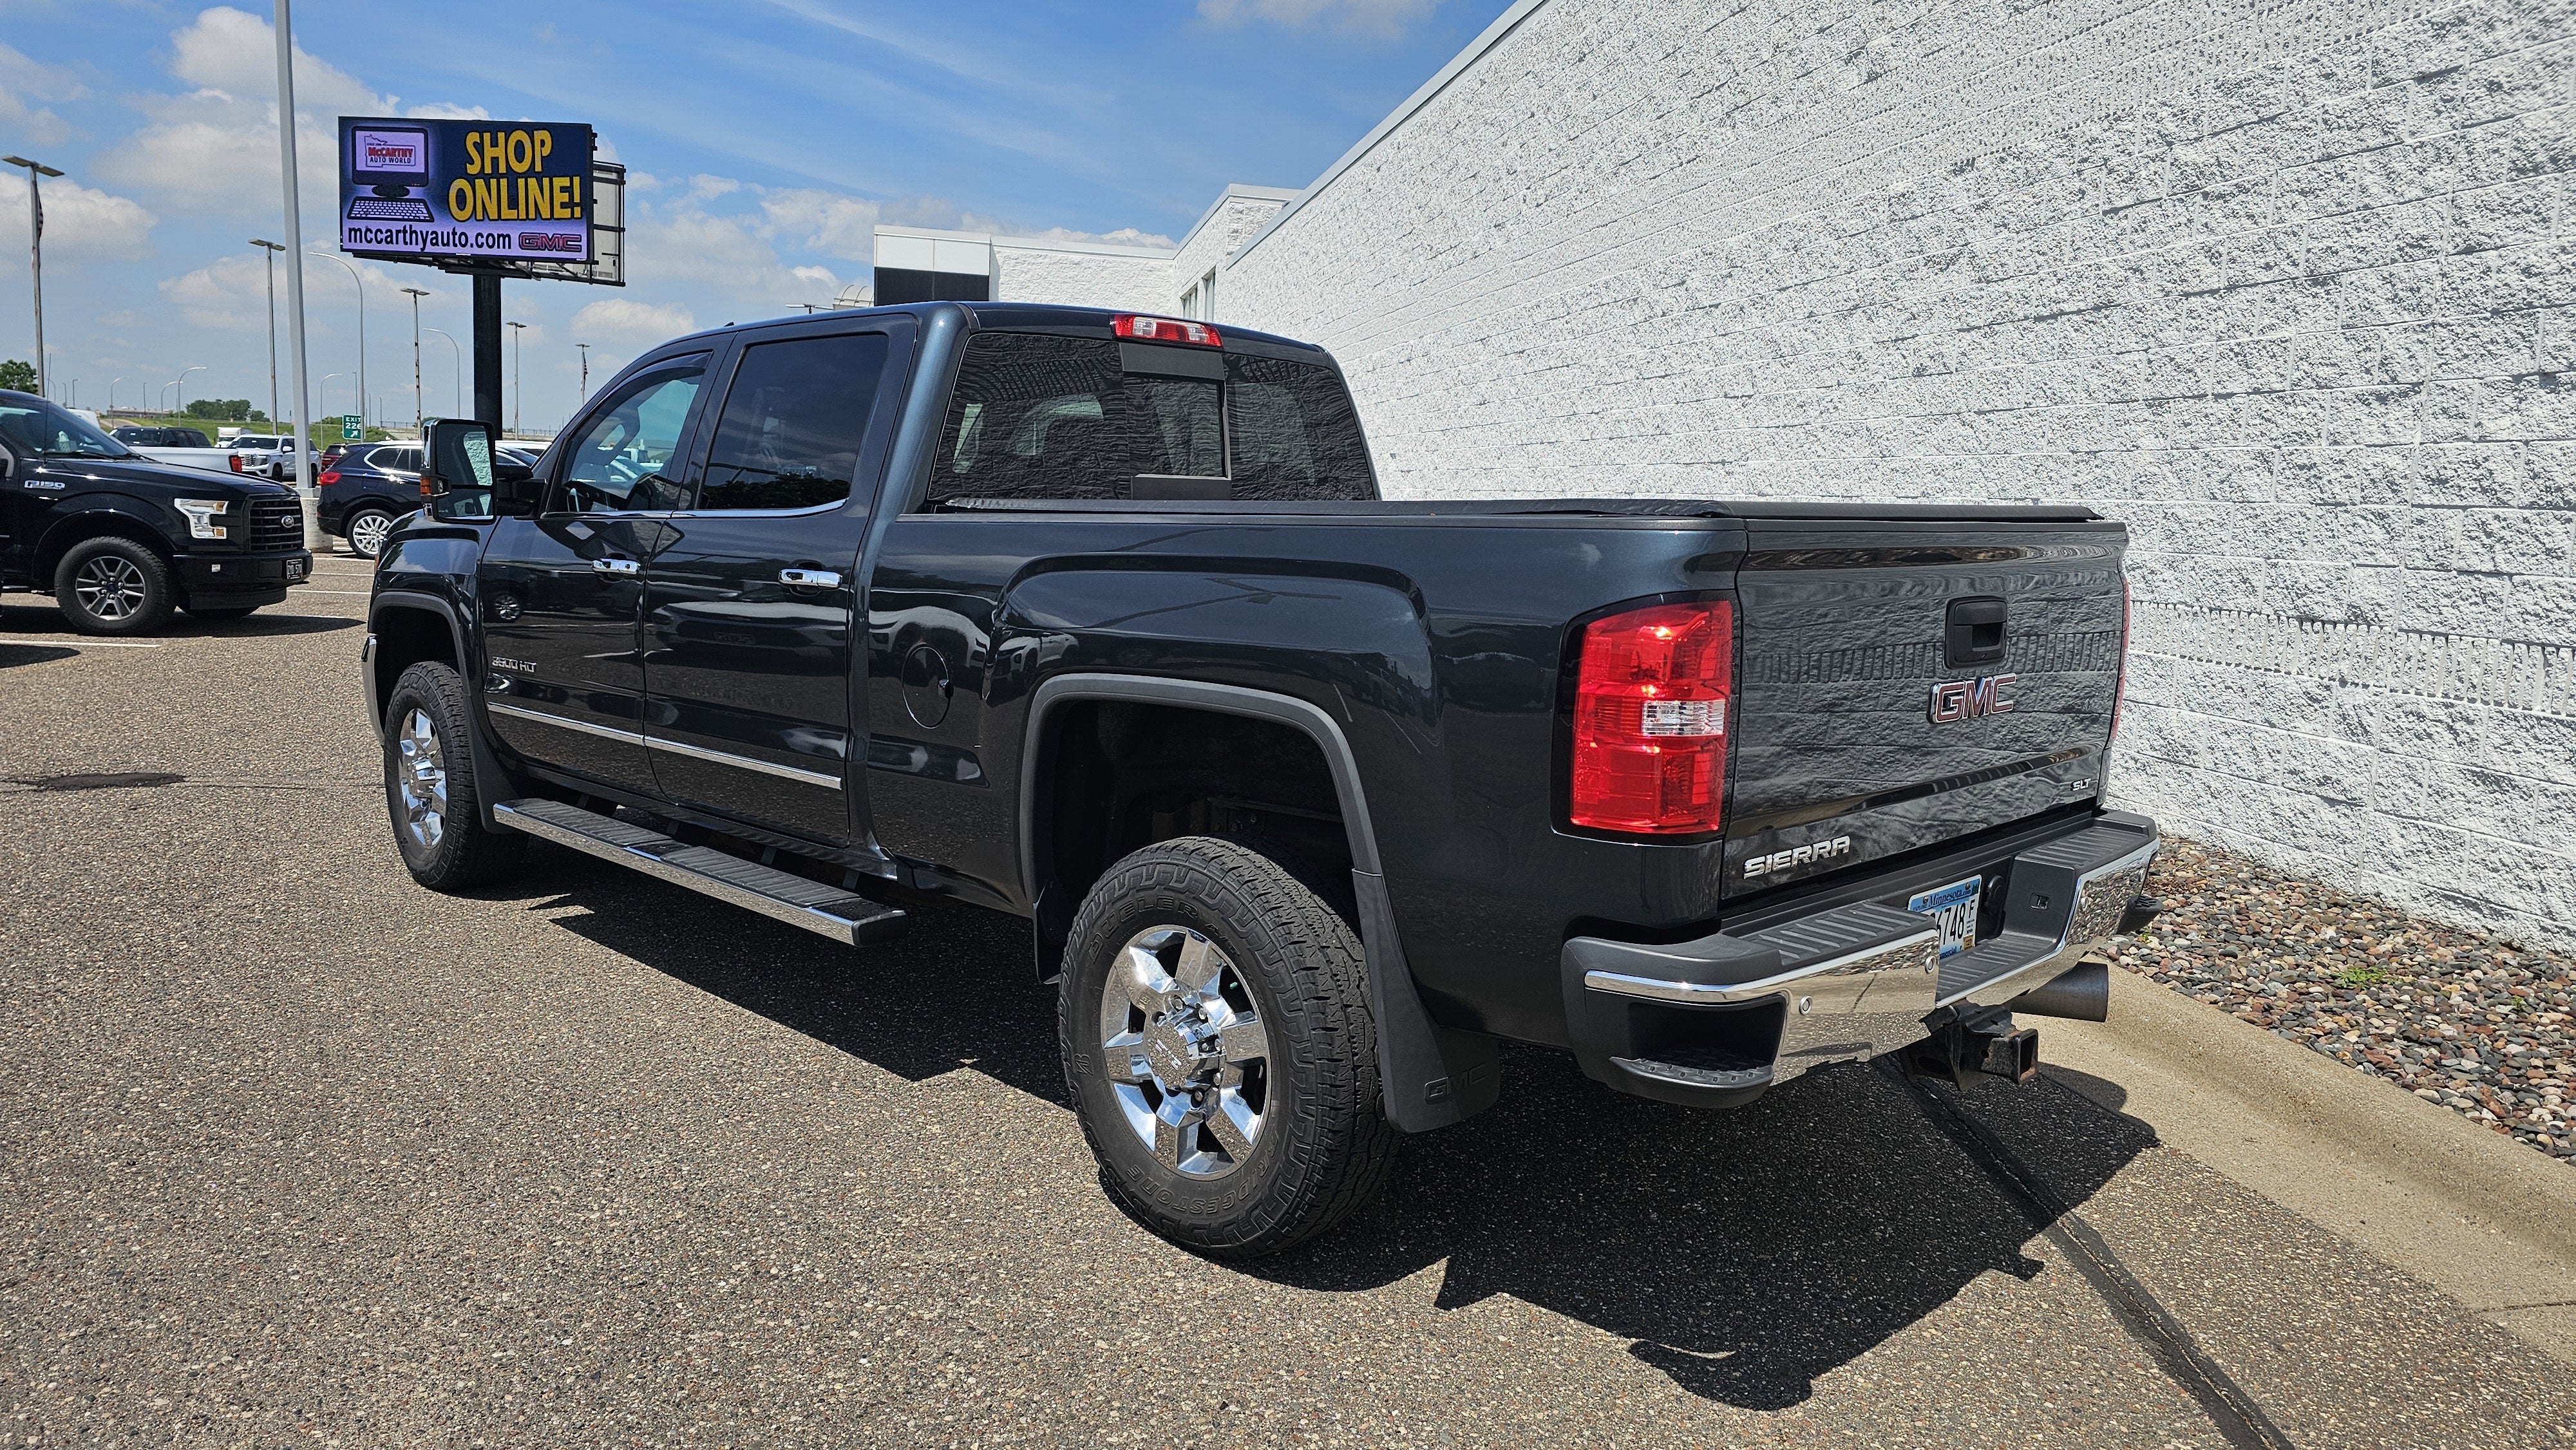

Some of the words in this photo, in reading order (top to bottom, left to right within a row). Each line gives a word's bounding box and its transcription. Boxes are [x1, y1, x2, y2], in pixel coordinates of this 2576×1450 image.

[466, 130, 552, 174] SHOP
[449, 176, 581, 221] ONLINE!
[348, 224, 511, 252] mccarthyauto.com
[519, 232, 582, 252] GMC
[520, 661, 537, 673] HD
[1928, 673, 2016, 724] GMC
[2072, 778, 2092, 791] SLT
[1743, 835, 1850, 880] SIERRA
[1968, 899, 1976, 919] F
